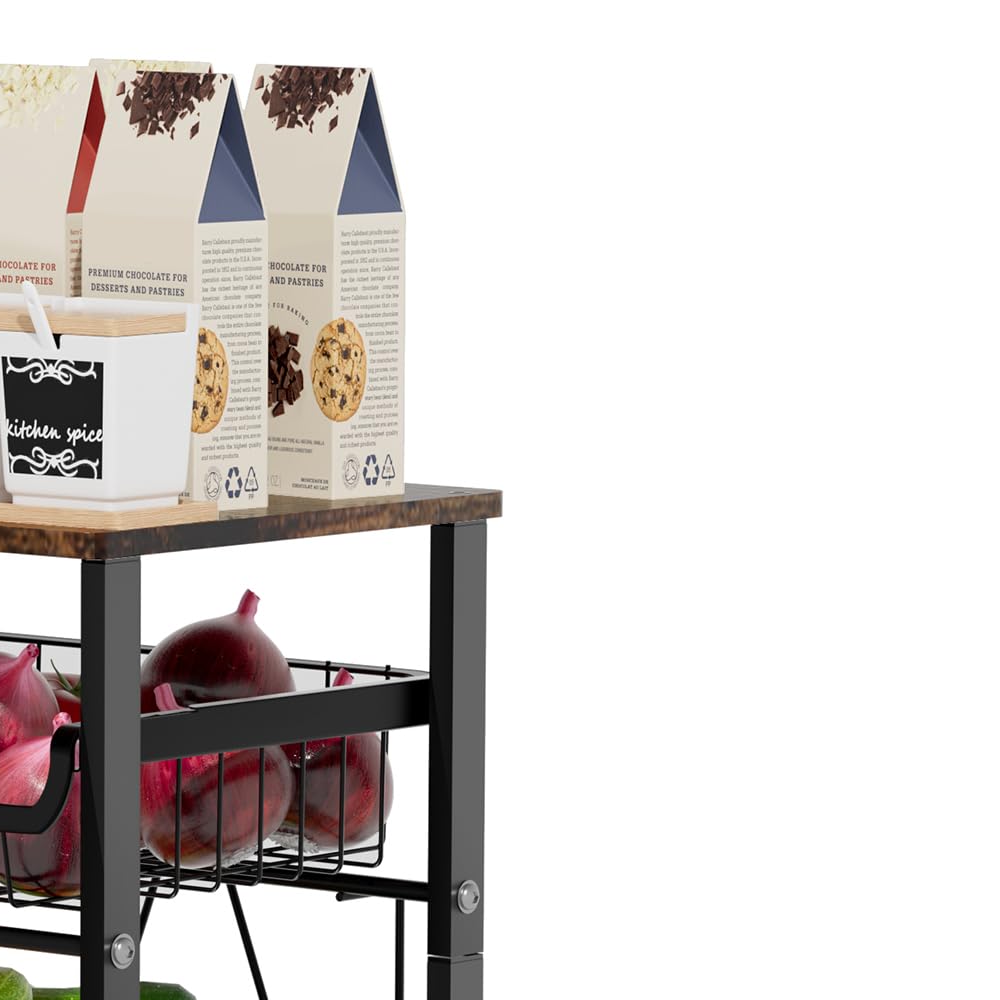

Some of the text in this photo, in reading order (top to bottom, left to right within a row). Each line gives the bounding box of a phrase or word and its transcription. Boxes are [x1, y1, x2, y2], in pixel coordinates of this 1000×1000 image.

[40, 262, 57, 272] FOR
[311, 264, 327, 273] FOR
[15, 275, 54, 286] PASTRIES
[88, 267, 188, 283] PREMIUM CHOCOLATE FOR
[269, 275, 325, 288] AND PASTRIES
[90, 282, 185, 297] DESSERTS AND PASTRIES
[286, 304, 310, 326] BAKING
[5, 418, 104, 447] kitchen spice
